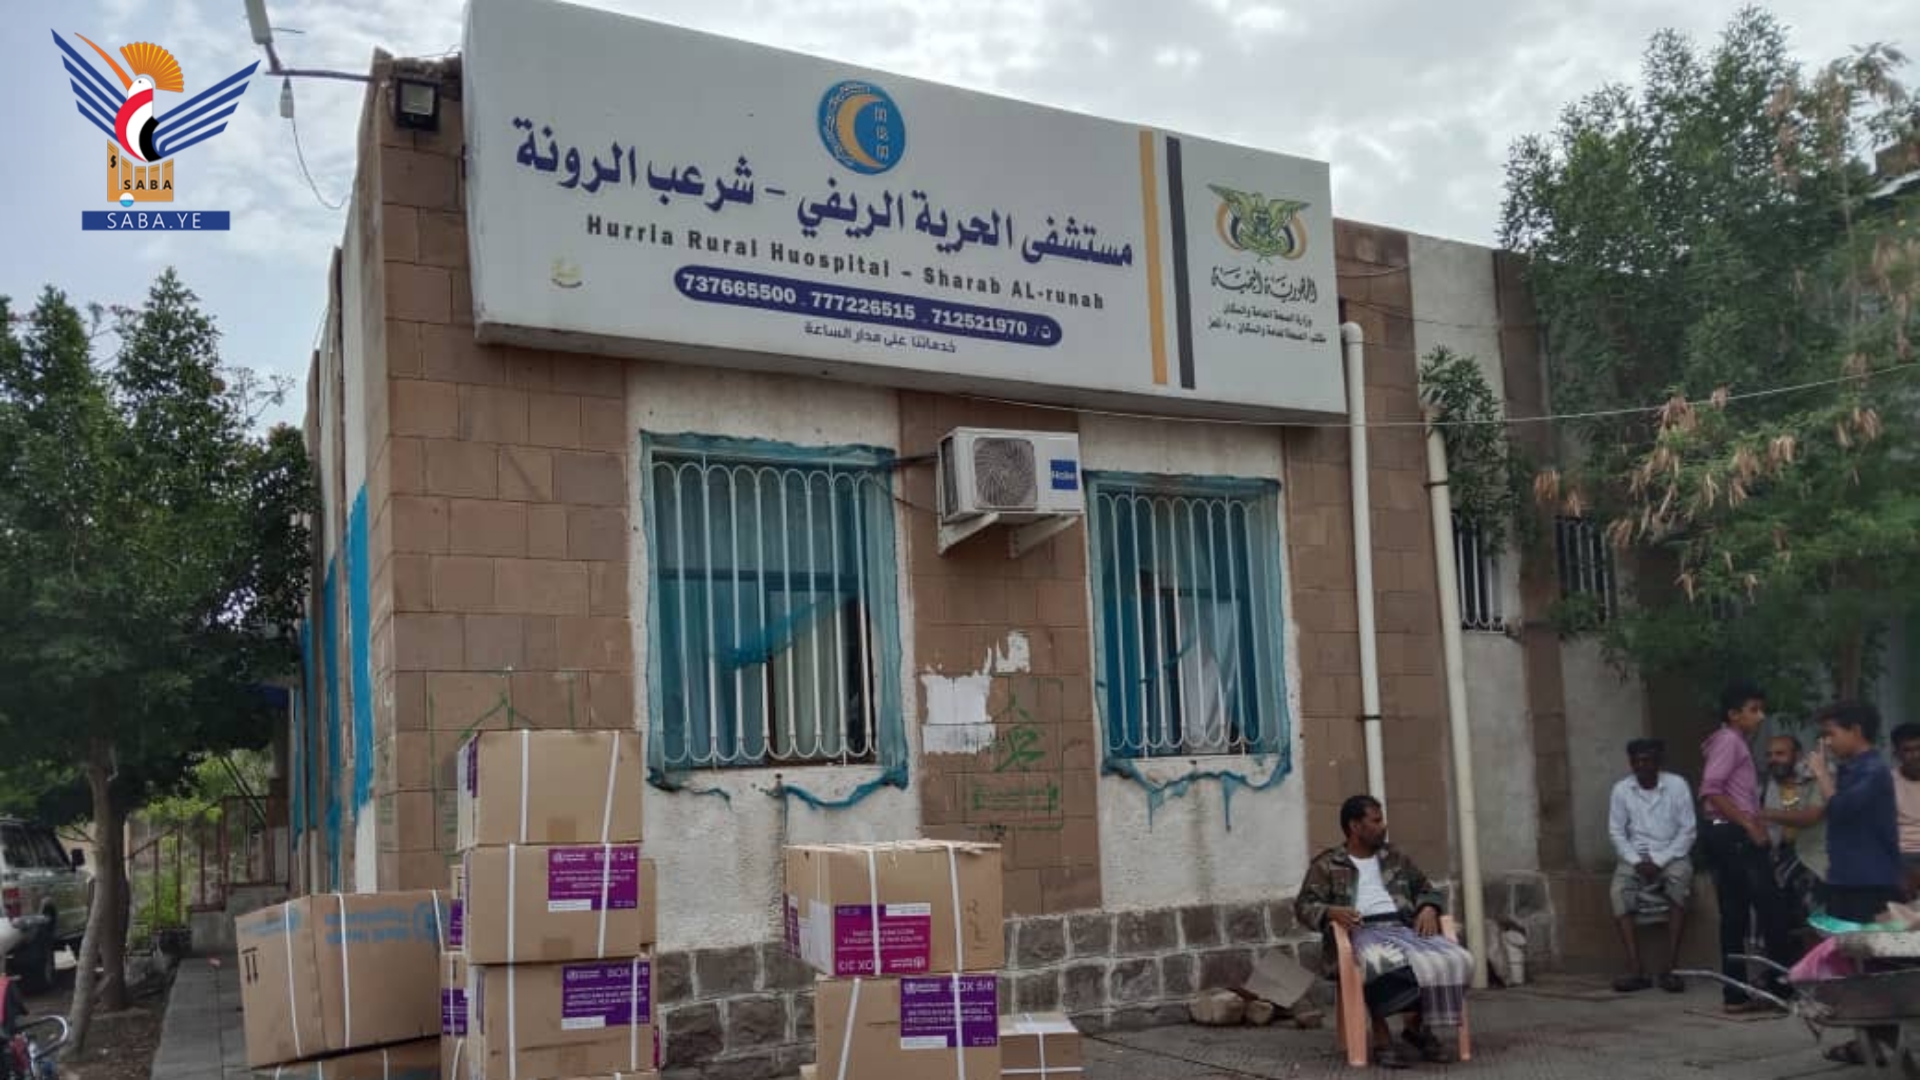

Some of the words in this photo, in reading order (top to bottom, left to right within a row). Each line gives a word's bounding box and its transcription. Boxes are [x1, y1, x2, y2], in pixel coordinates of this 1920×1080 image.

[513, 116, 637, 193] الرونة
[647, 155, 754, 213] شرعب
[797, 177, 904, 239] الريفي
[911, 189, 1013, 254] الحرية
[1021, 215, 1133, 266] مستشفى
[688, 229, 757, 258] Rural
[770, 241, 889, 278] Huospital
[923, 266, 1001, 294] Sharab
[1011, 279, 1104, 309] AL-runah
[682, 273, 797, 304] 737665500
[810, 291, 916, 321] 777226515
[931, 308, 1028, 336] 712521970
[804, 321, 852, 339] الساعة
[854, 328, 881, 344] مدار
[884, 333, 907, 348] على
[911, 335, 957, 354] خدماتنا
